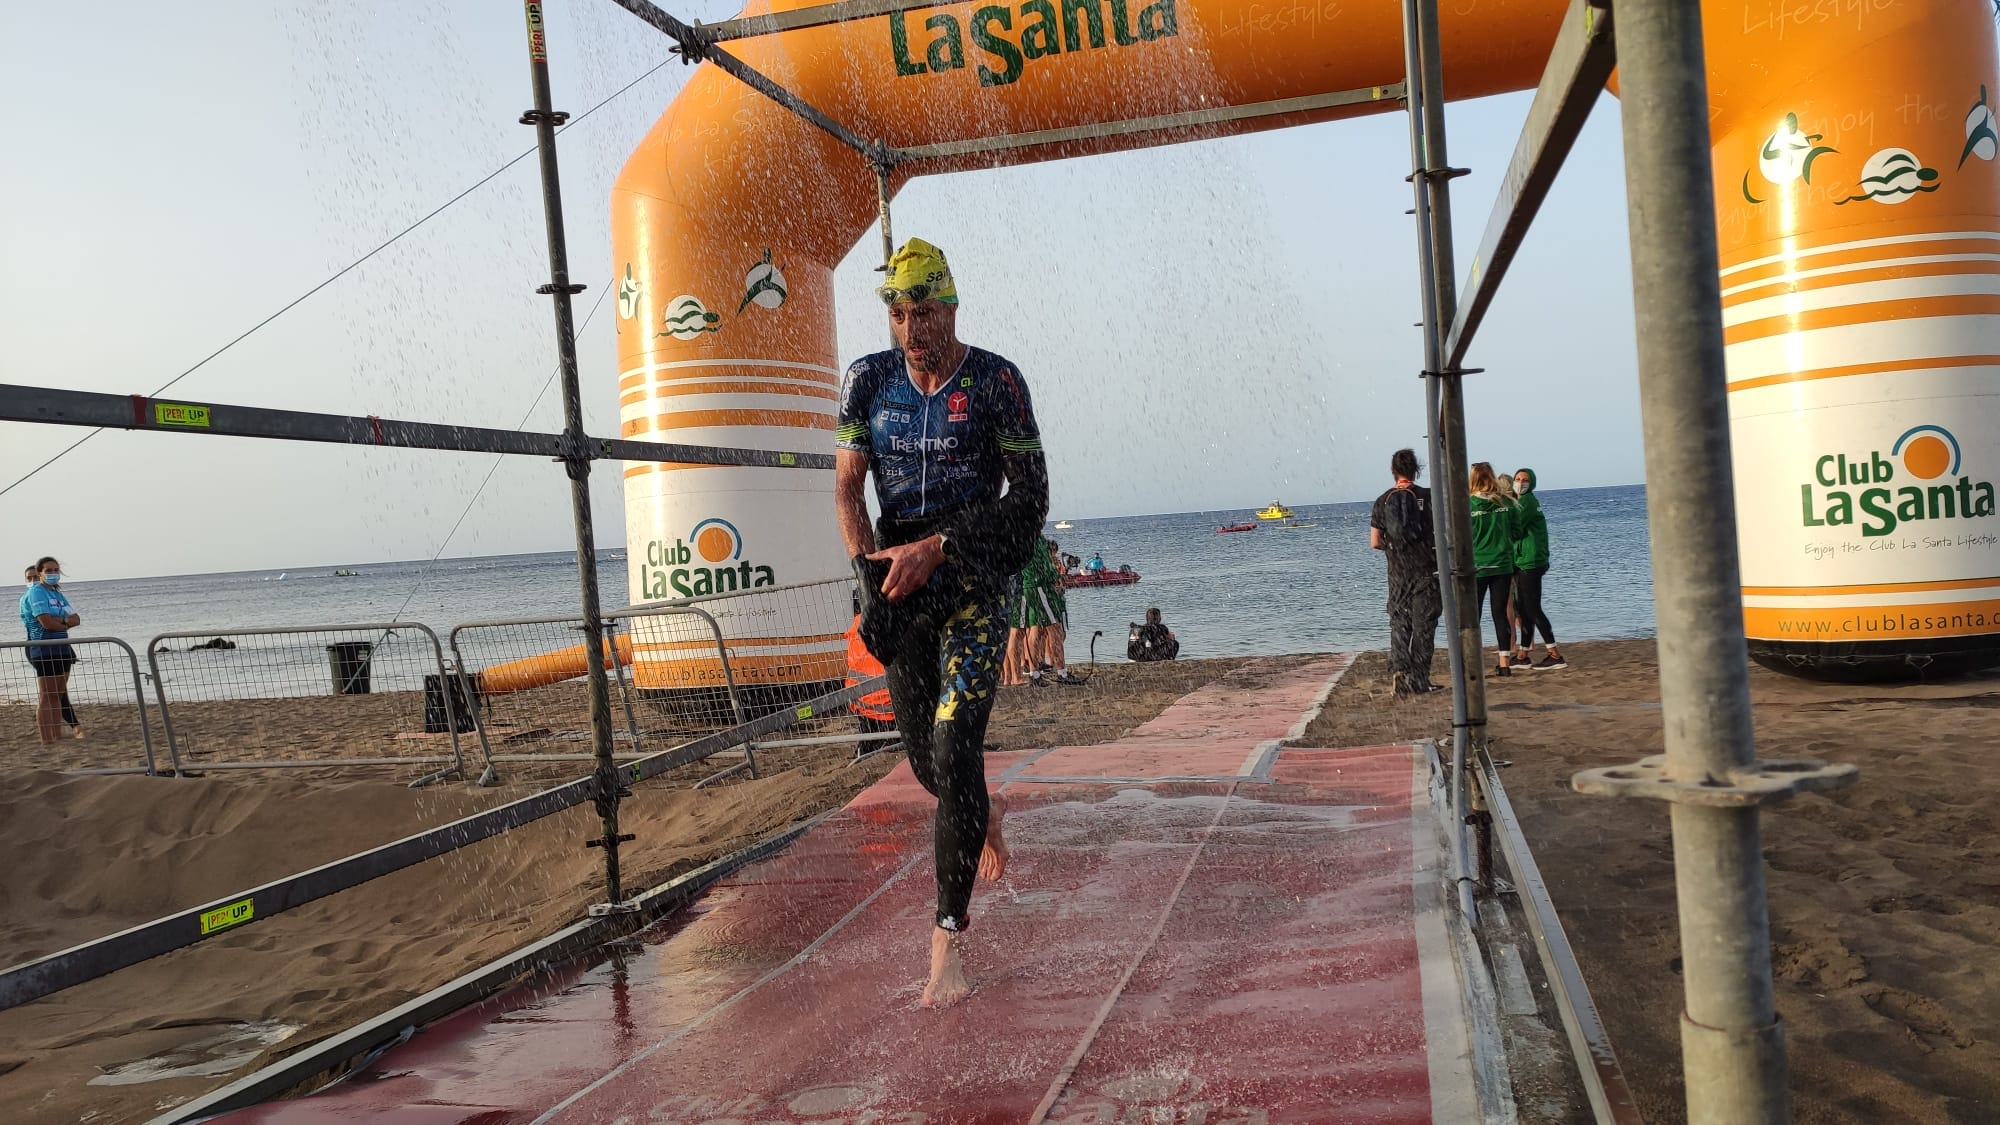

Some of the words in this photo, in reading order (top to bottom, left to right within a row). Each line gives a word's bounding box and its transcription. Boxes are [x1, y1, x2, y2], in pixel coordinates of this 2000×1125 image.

[529, 4, 541, 24] UP
[533, 29, 544, 53] PERI
[189, 409, 204, 420] UP
[1815, 451, 1894, 487] Club
[647, 538, 691, 567] Club
[1804, 543, 1835, 560] Enjoy
[1841, 541, 1863, 554] the
[1869, 539, 1896, 551] Club
[1902, 537, 1917, 550] La
[1922, 535, 1952, 550] Santa
[1957, 532, 1998, 551] Lifestyle
[232, 905, 248, 919] UP
